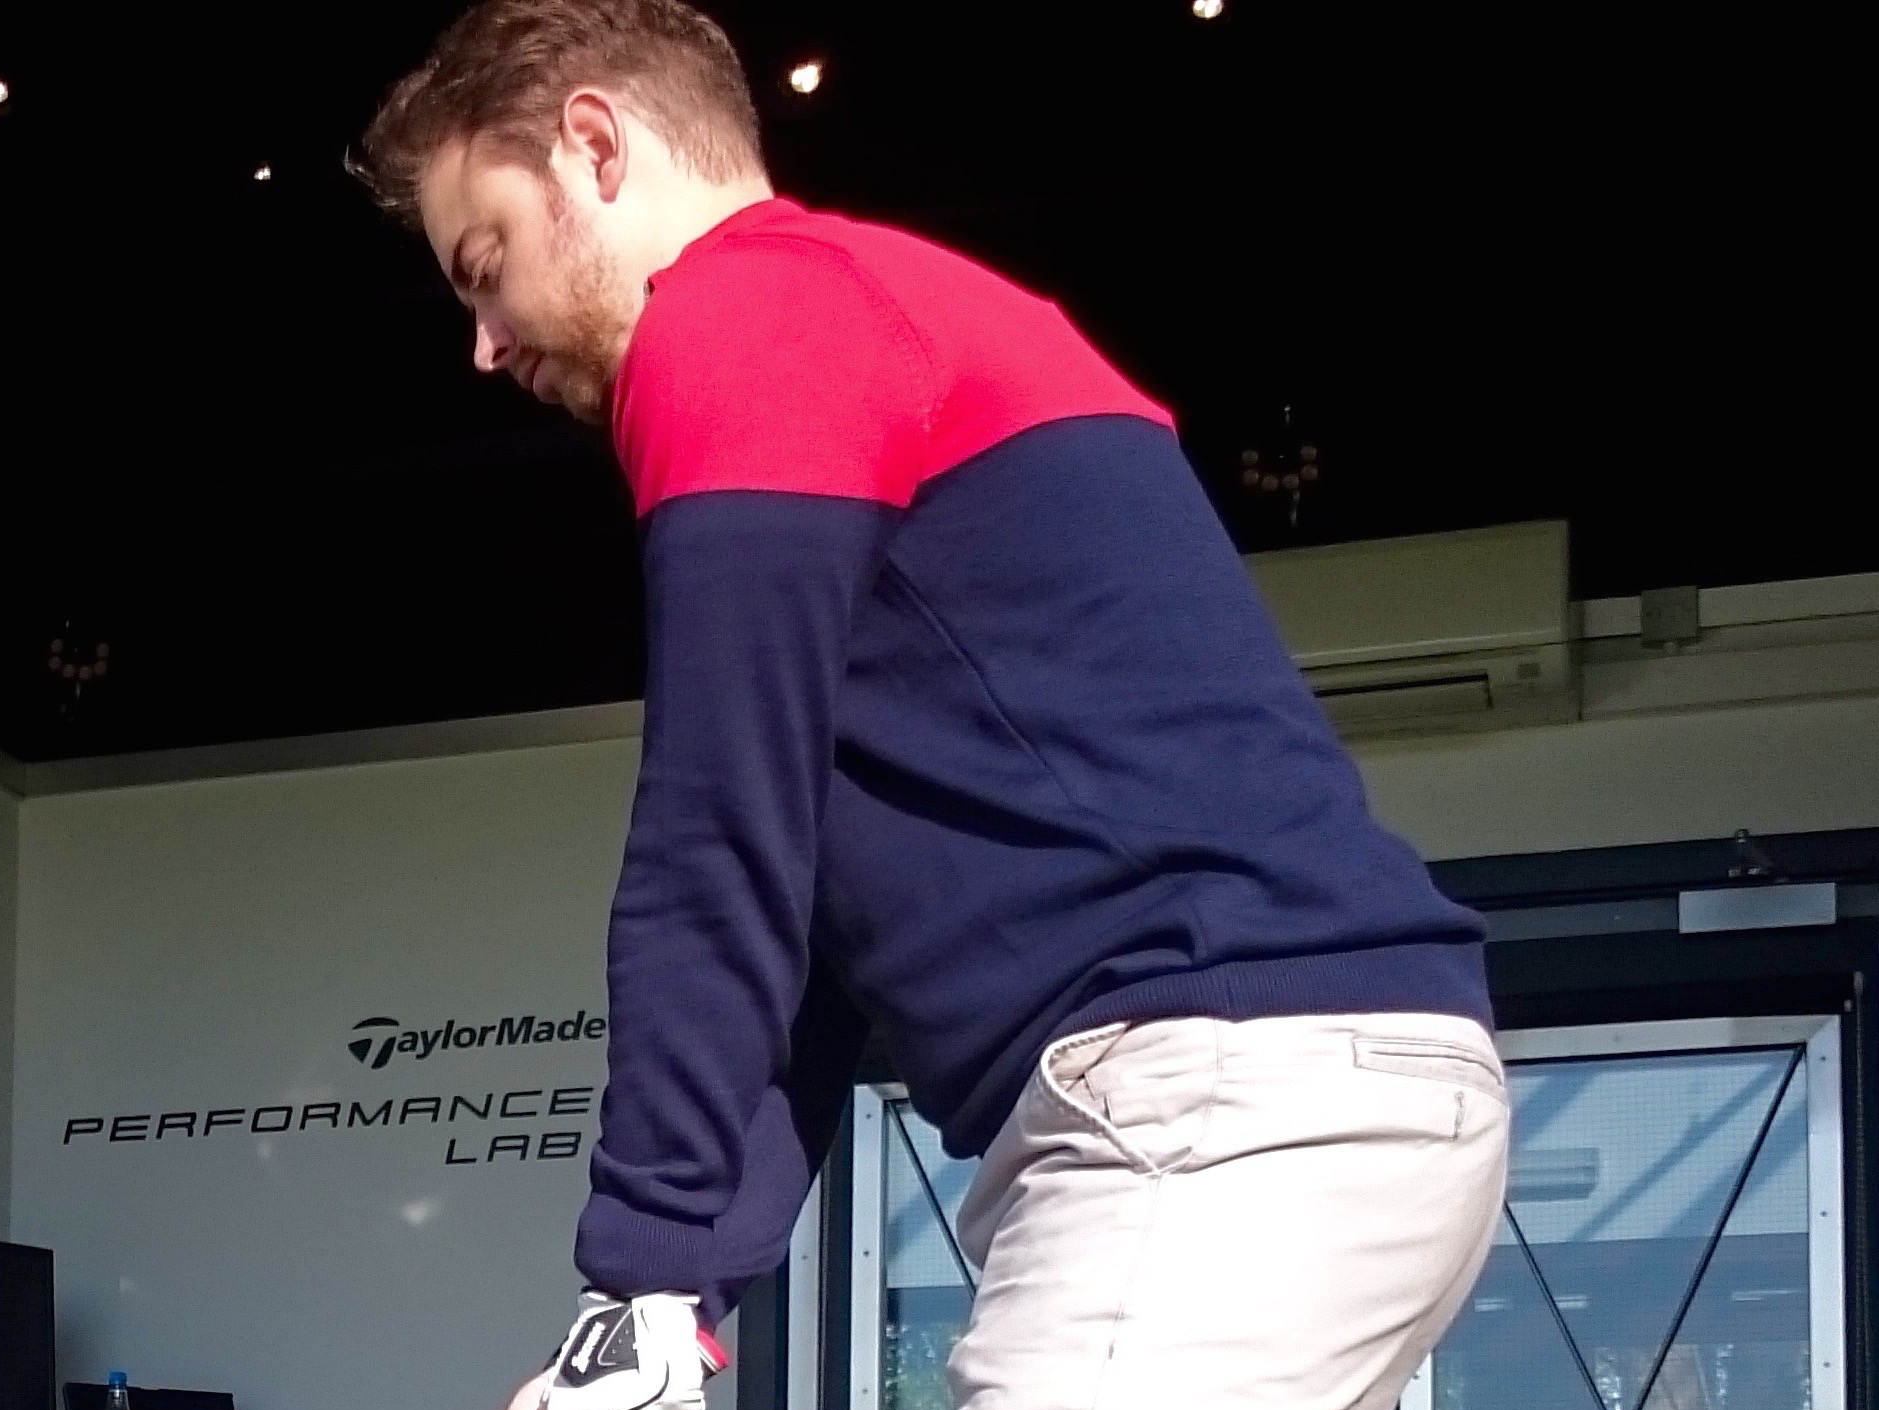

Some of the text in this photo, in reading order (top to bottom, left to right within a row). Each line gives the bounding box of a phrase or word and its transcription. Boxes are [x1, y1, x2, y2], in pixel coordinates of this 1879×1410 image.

[347, 1010, 607, 1069] TaylorMade
[63, 1086, 595, 1145] PERFORMANCE
[445, 1131, 582, 1165] LAB
